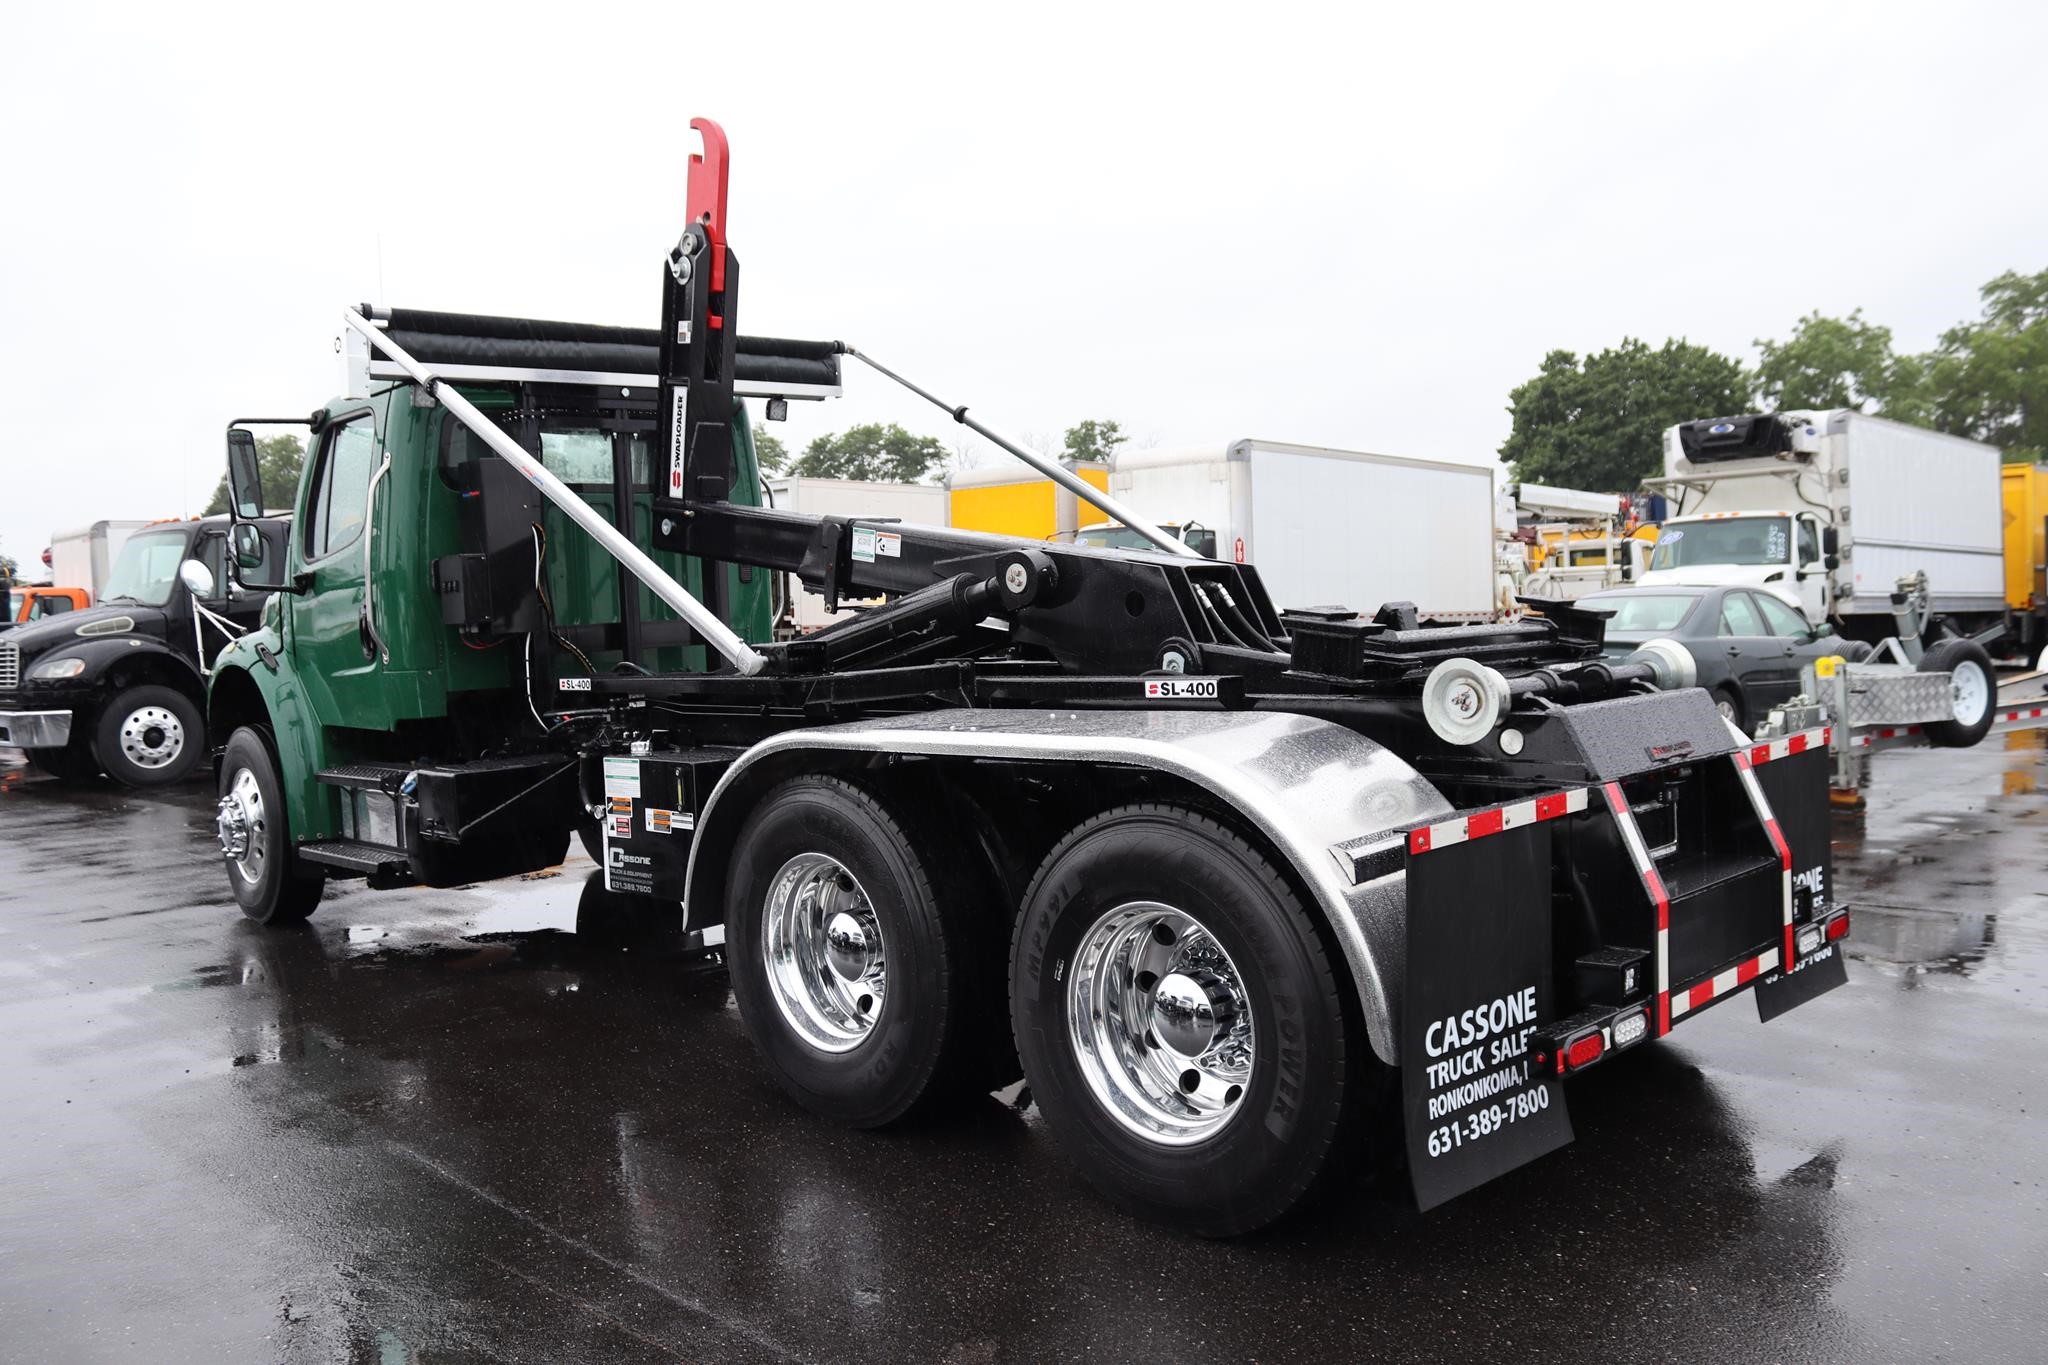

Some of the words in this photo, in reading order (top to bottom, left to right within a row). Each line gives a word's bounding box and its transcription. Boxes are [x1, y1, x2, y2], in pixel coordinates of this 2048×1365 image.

[674, 395, 684, 469] SWAPLOADER
[566, 679, 590, 690] SL-400
[1160, 681, 1216, 697] SL-400
[610, 847, 651, 868] CASSONE
[1425, 986, 1537, 1057] CASSONE
[1426, 1045, 1486, 1090] TRUCK
[1428, 1064, 1523, 1121] RONKONKOMA,
[1427, 1084, 1549, 1158] 631-389-7800
